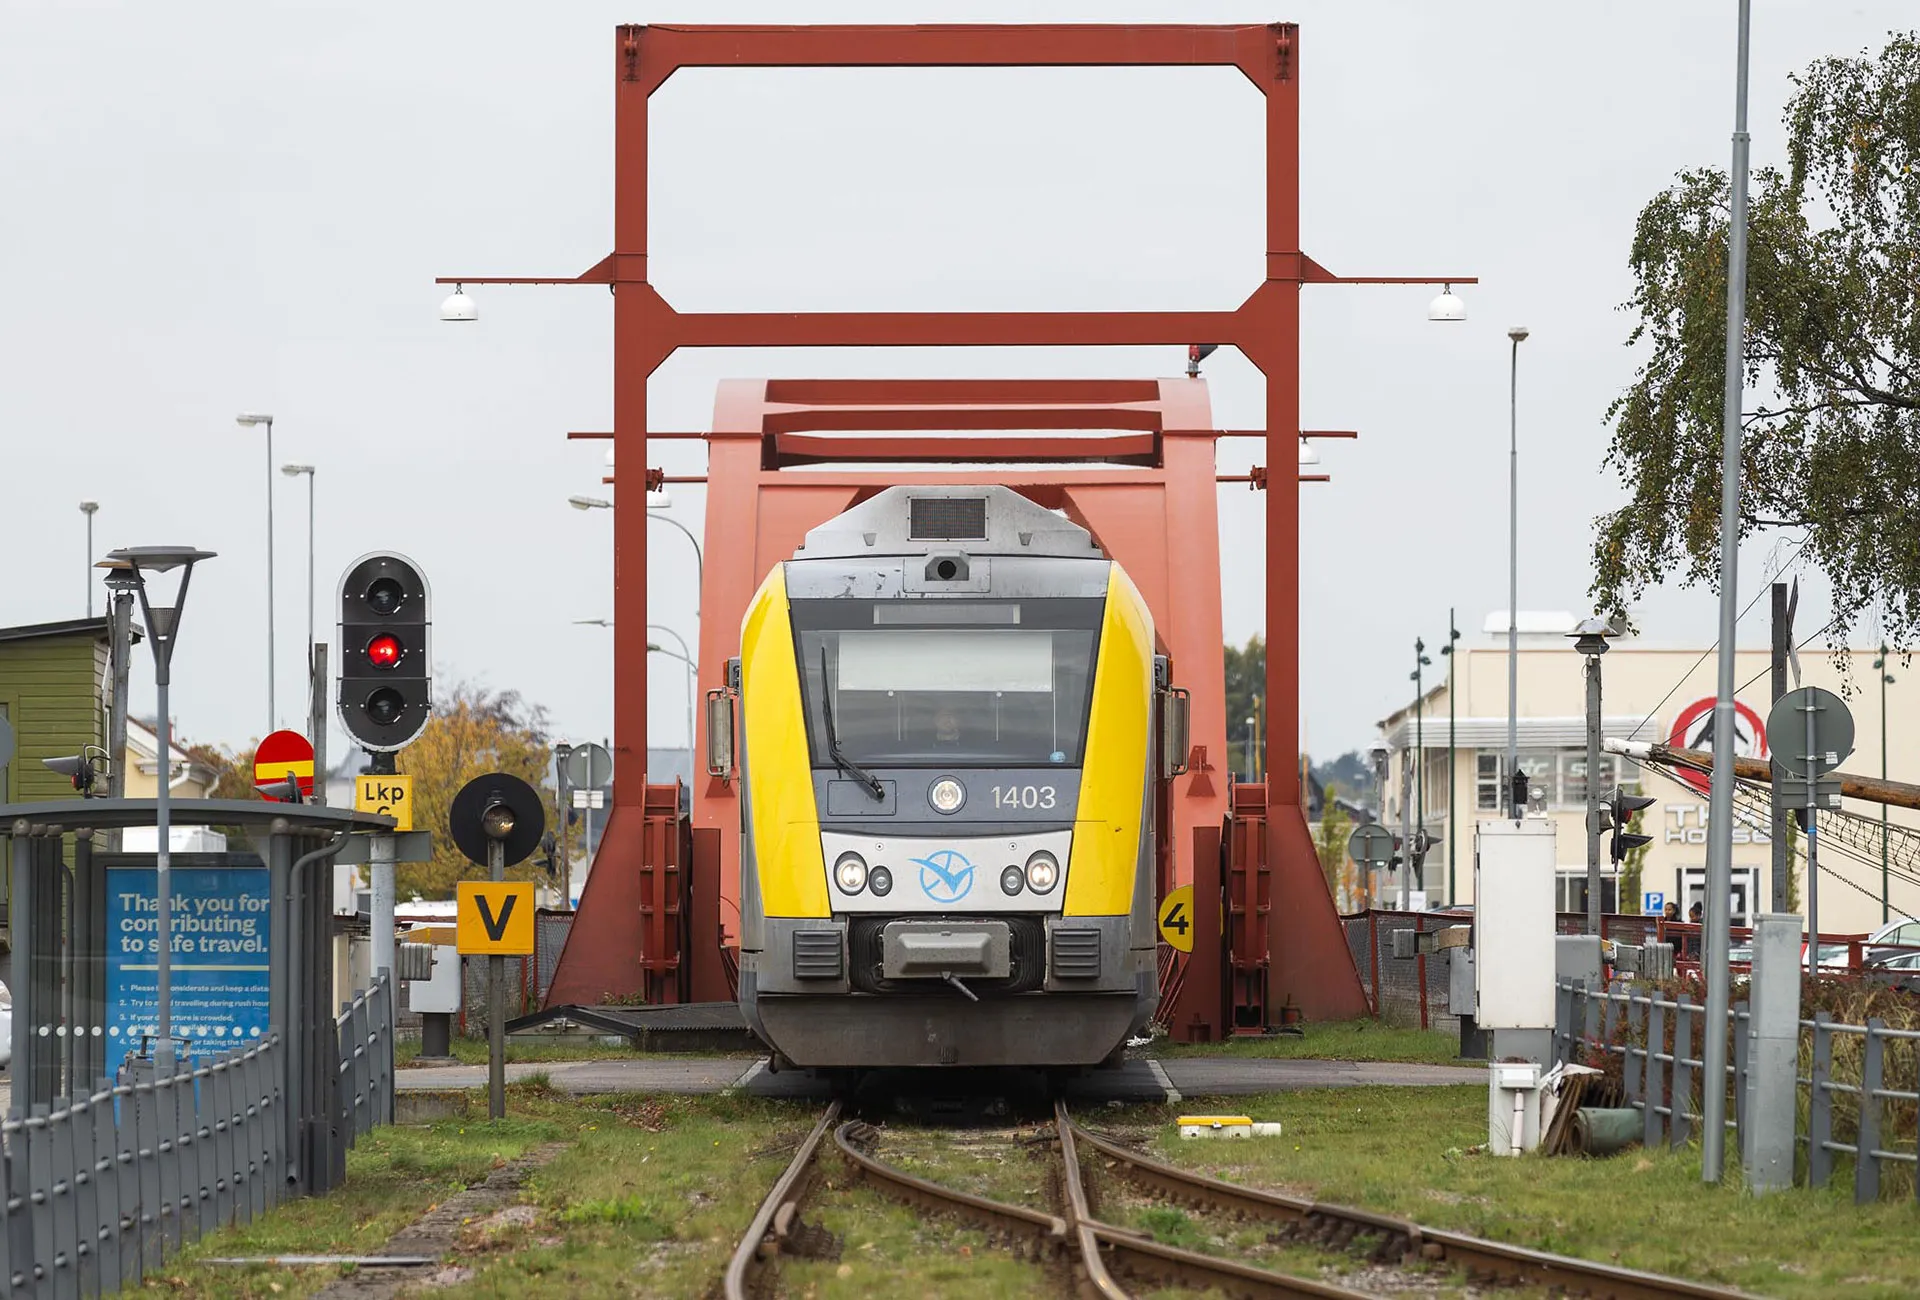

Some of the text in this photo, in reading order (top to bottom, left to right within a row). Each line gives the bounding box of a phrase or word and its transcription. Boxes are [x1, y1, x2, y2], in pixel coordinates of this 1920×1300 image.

[365, 783, 404, 805] Lkp
[991, 786, 1056, 809] 1403
[1665, 828, 1772, 845] HOSE
[194, 898, 234, 916] you
[238, 893, 270, 912] for
[1649, 894, 1662, 911] P
[120, 913, 257, 937] conributing
[473, 895, 518, 941] V
[1163, 902, 1190, 936] 4
[121, 935, 144, 953] to
[199, 934, 268, 953] travel.
[169, 984, 209, 992] onsiderate
[119, 999, 127, 1007] 2.
[131, 1000, 144, 1008] Try
[209, 999, 234, 1008] during
